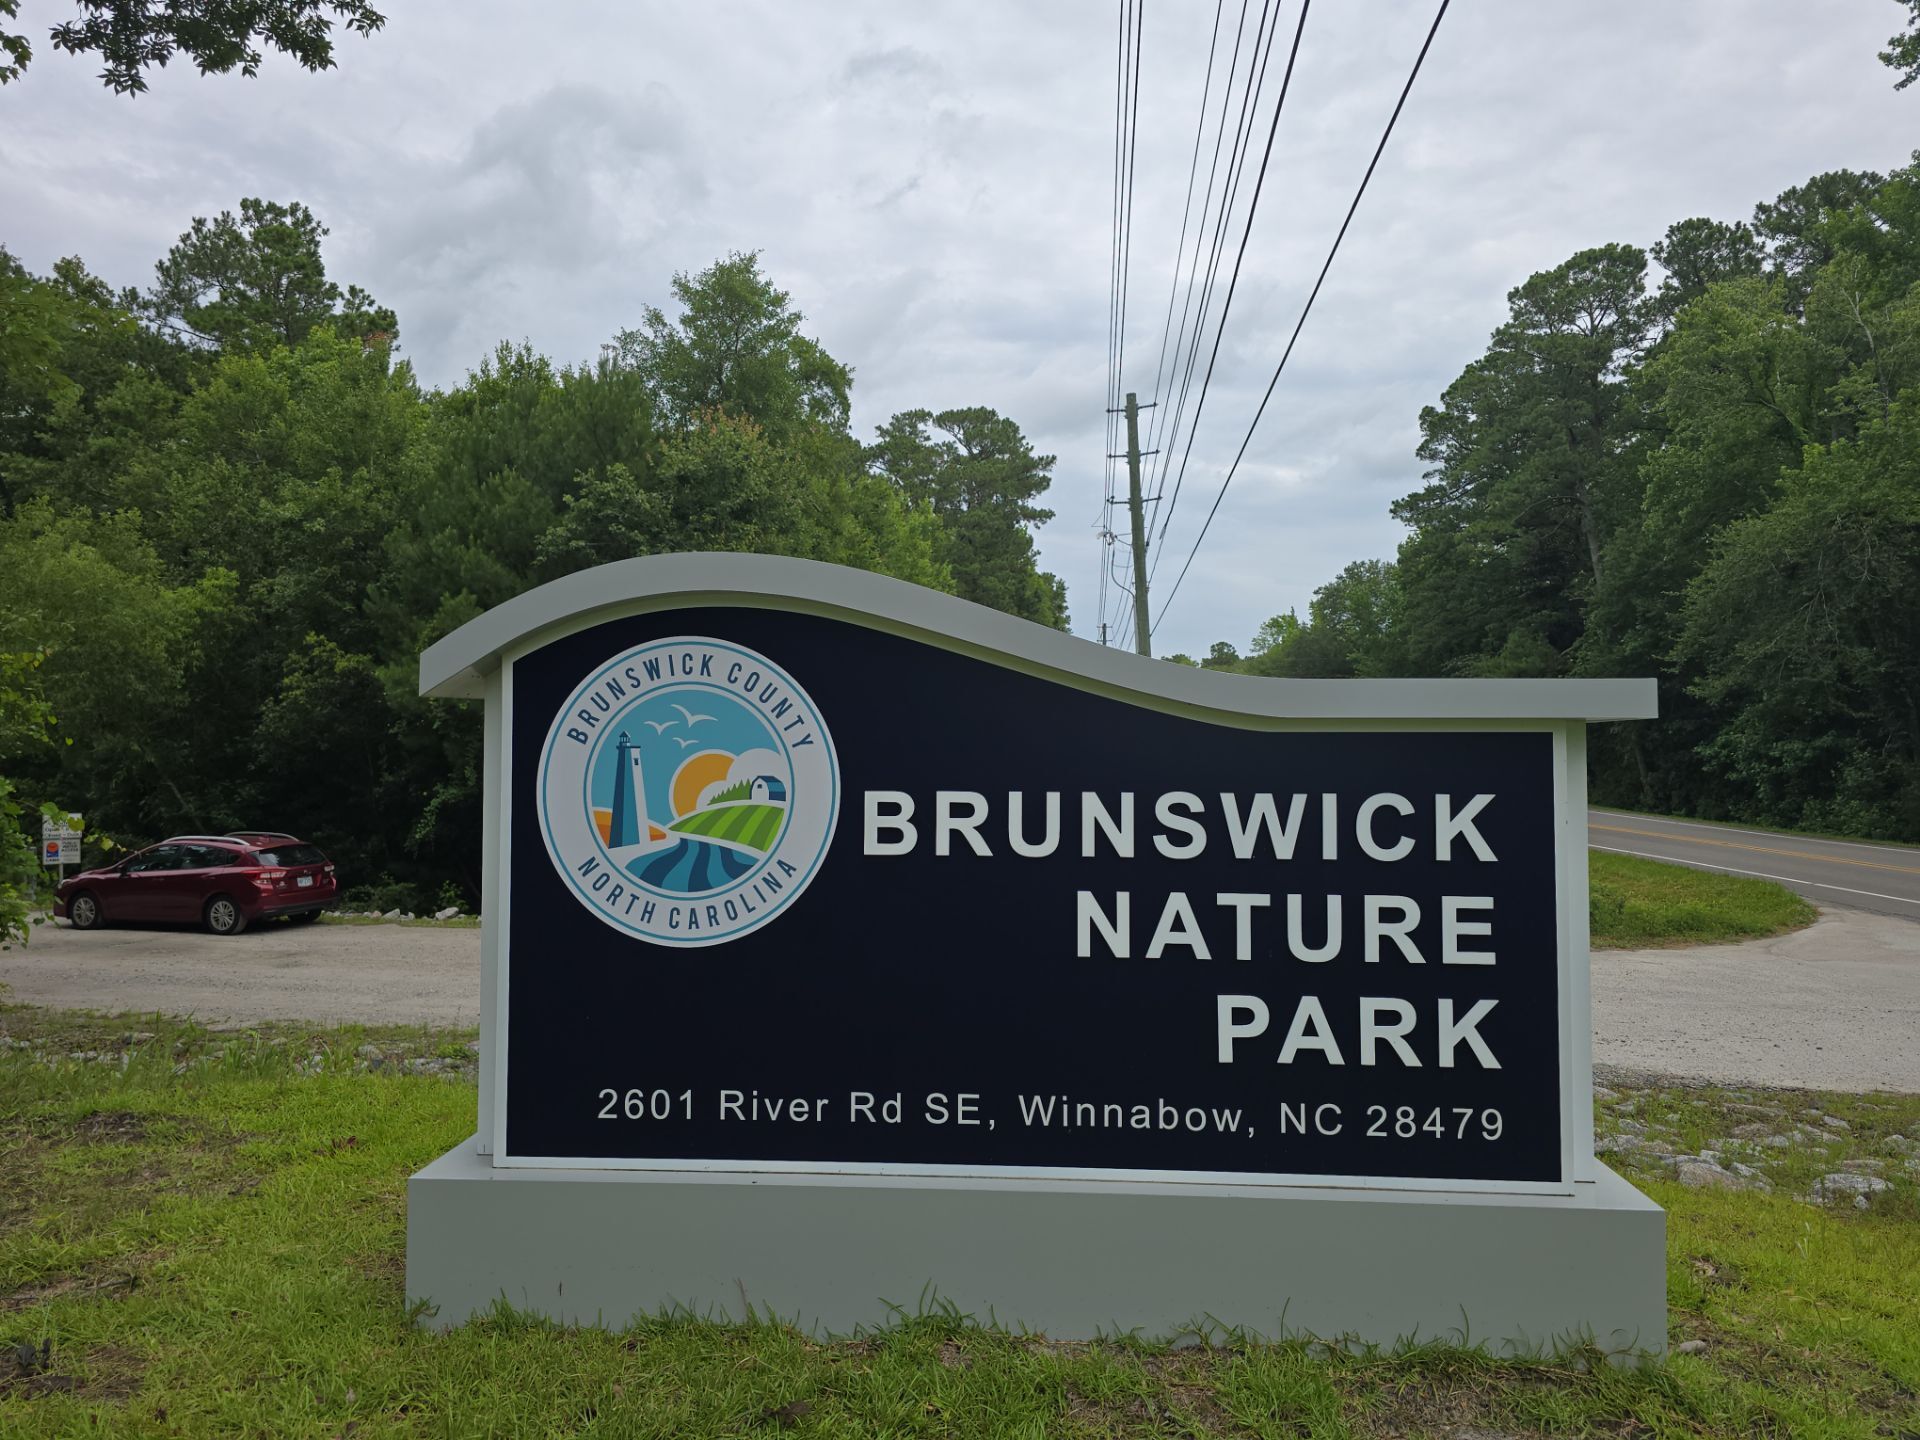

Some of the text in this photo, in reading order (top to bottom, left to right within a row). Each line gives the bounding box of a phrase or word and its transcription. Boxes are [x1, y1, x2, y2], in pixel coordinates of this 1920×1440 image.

[566, 652, 814, 749] BRUNSWICK COUNTY
[862, 789, 1499, 862] BRUNSWICK
[577, 855, 798, 930] NORTH CAROLINA
[1075, 889, 1498, 966] NATURE
[1216, 994, 1502, 1069] PARK
[597, 1088, 1503, 1141] 2601 River Rd SE, Winnabow, NC 28479
